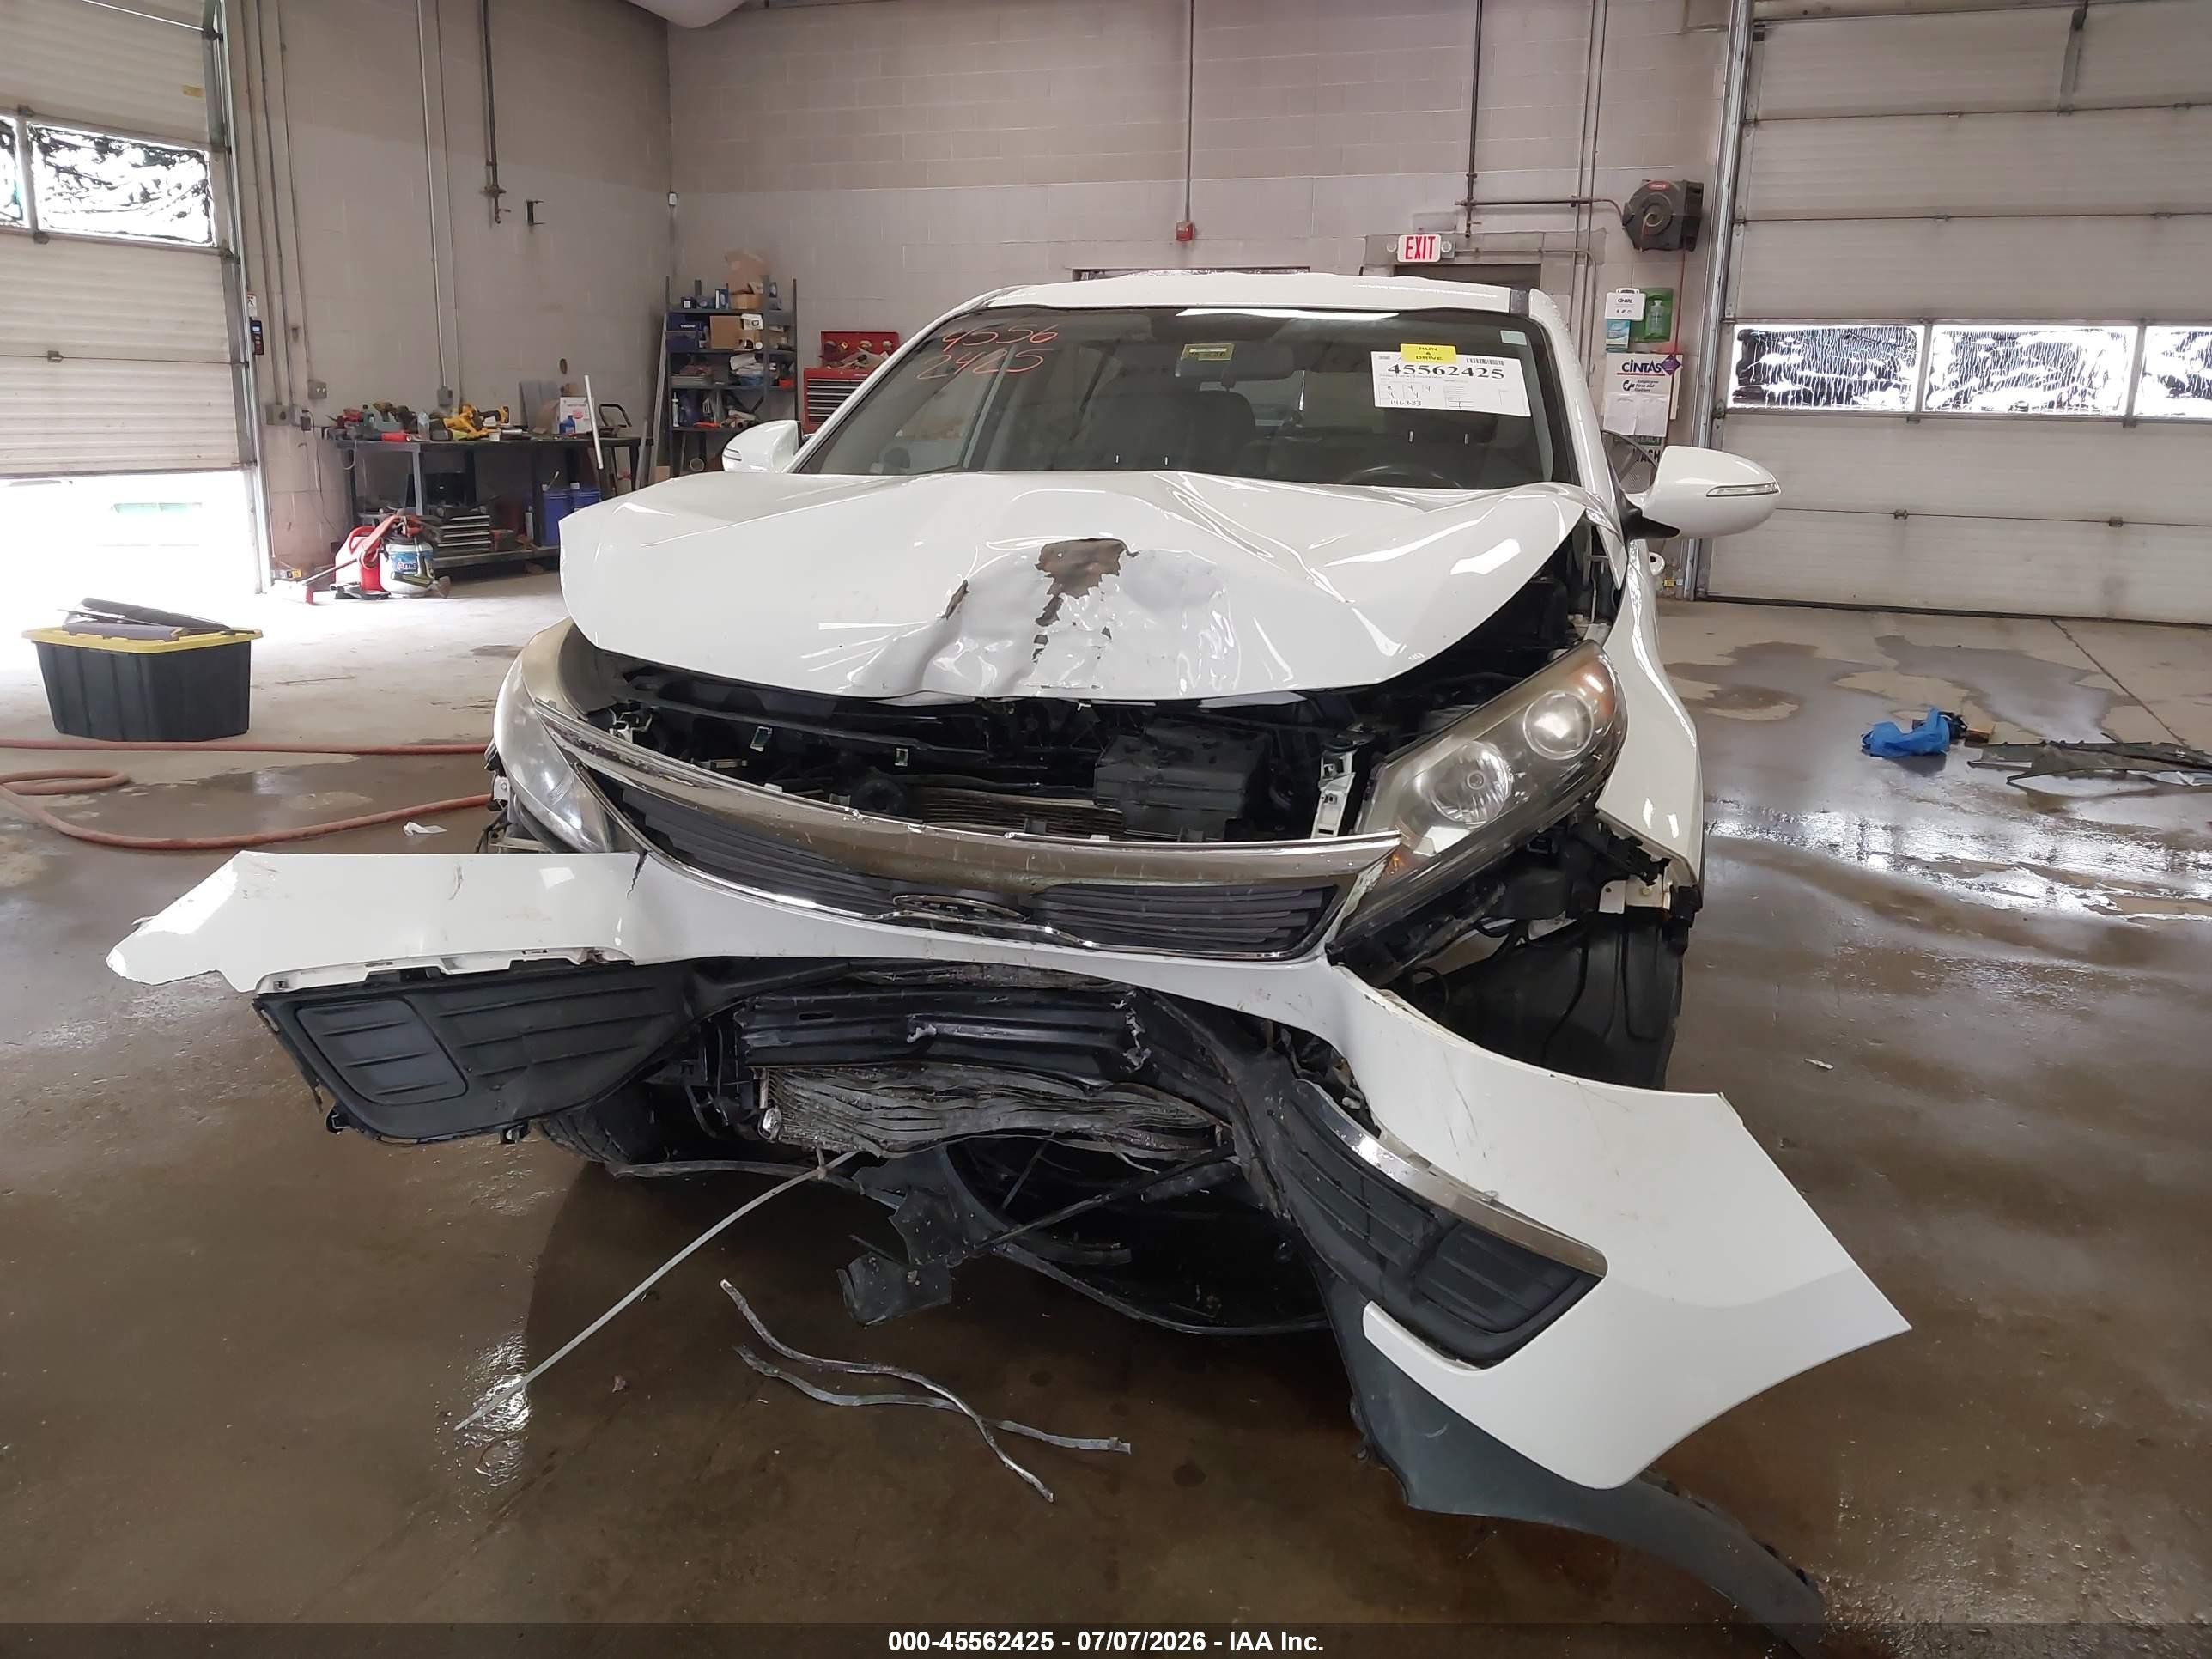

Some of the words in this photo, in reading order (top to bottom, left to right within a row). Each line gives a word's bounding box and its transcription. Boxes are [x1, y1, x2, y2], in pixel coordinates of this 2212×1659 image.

[1405, 236, 1436, 259] EXIT
[917, 348, 1054, 380] 2425
[1387, 363, 1504, 380] 45562425
